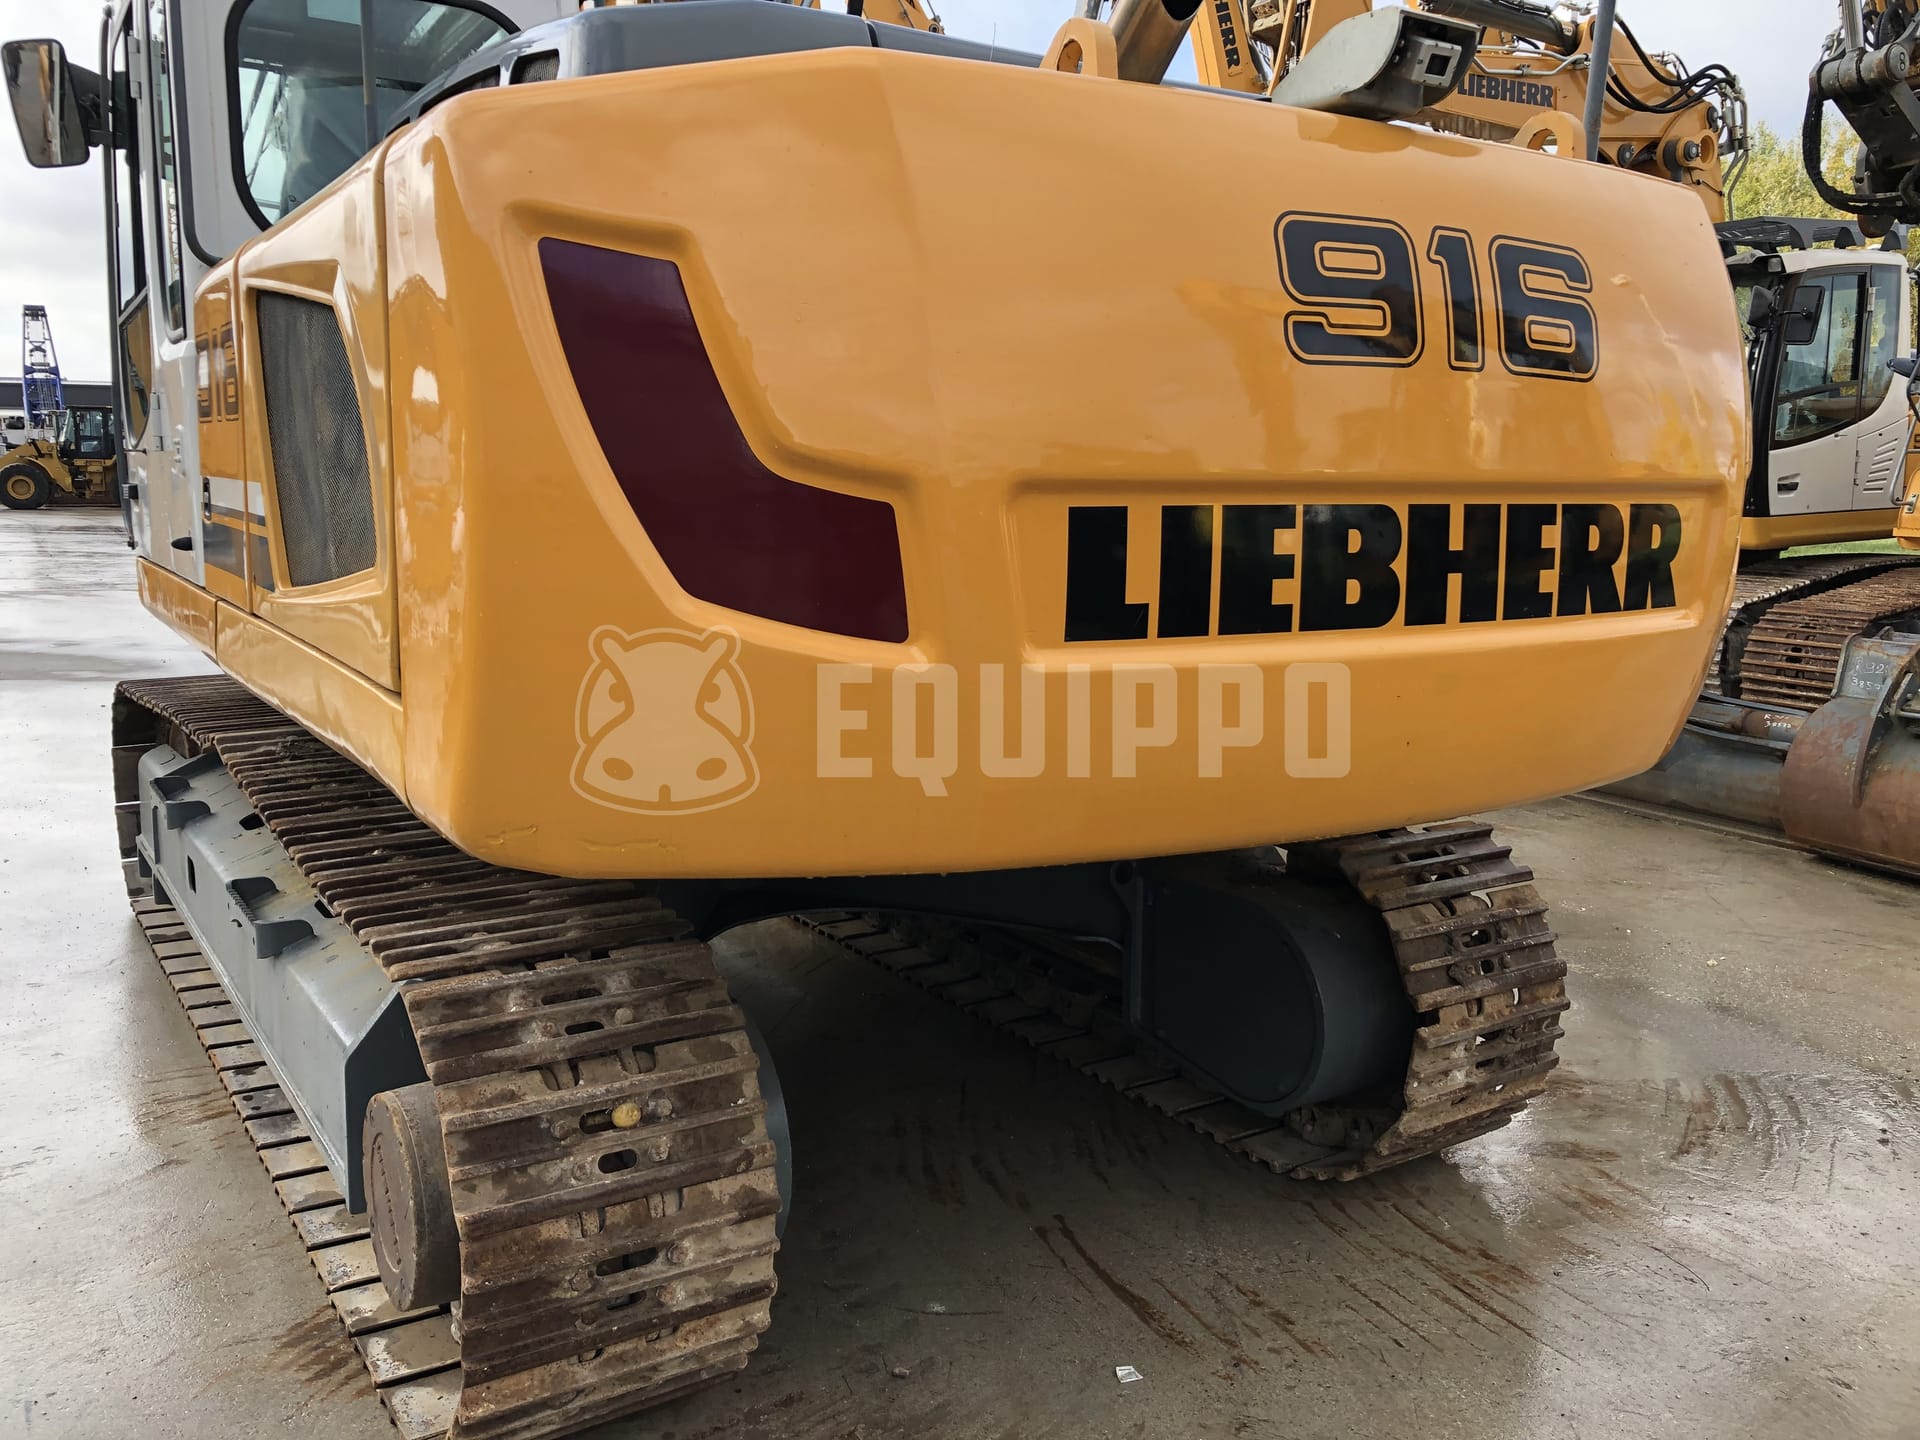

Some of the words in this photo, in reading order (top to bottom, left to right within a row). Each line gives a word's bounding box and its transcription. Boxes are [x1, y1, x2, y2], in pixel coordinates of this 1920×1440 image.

[1457, 73, 1554, 108] LIEBHERR
[1273, 210, 1600, 383] 916
[1064, 503, 1683, 642] LIEBHERR
